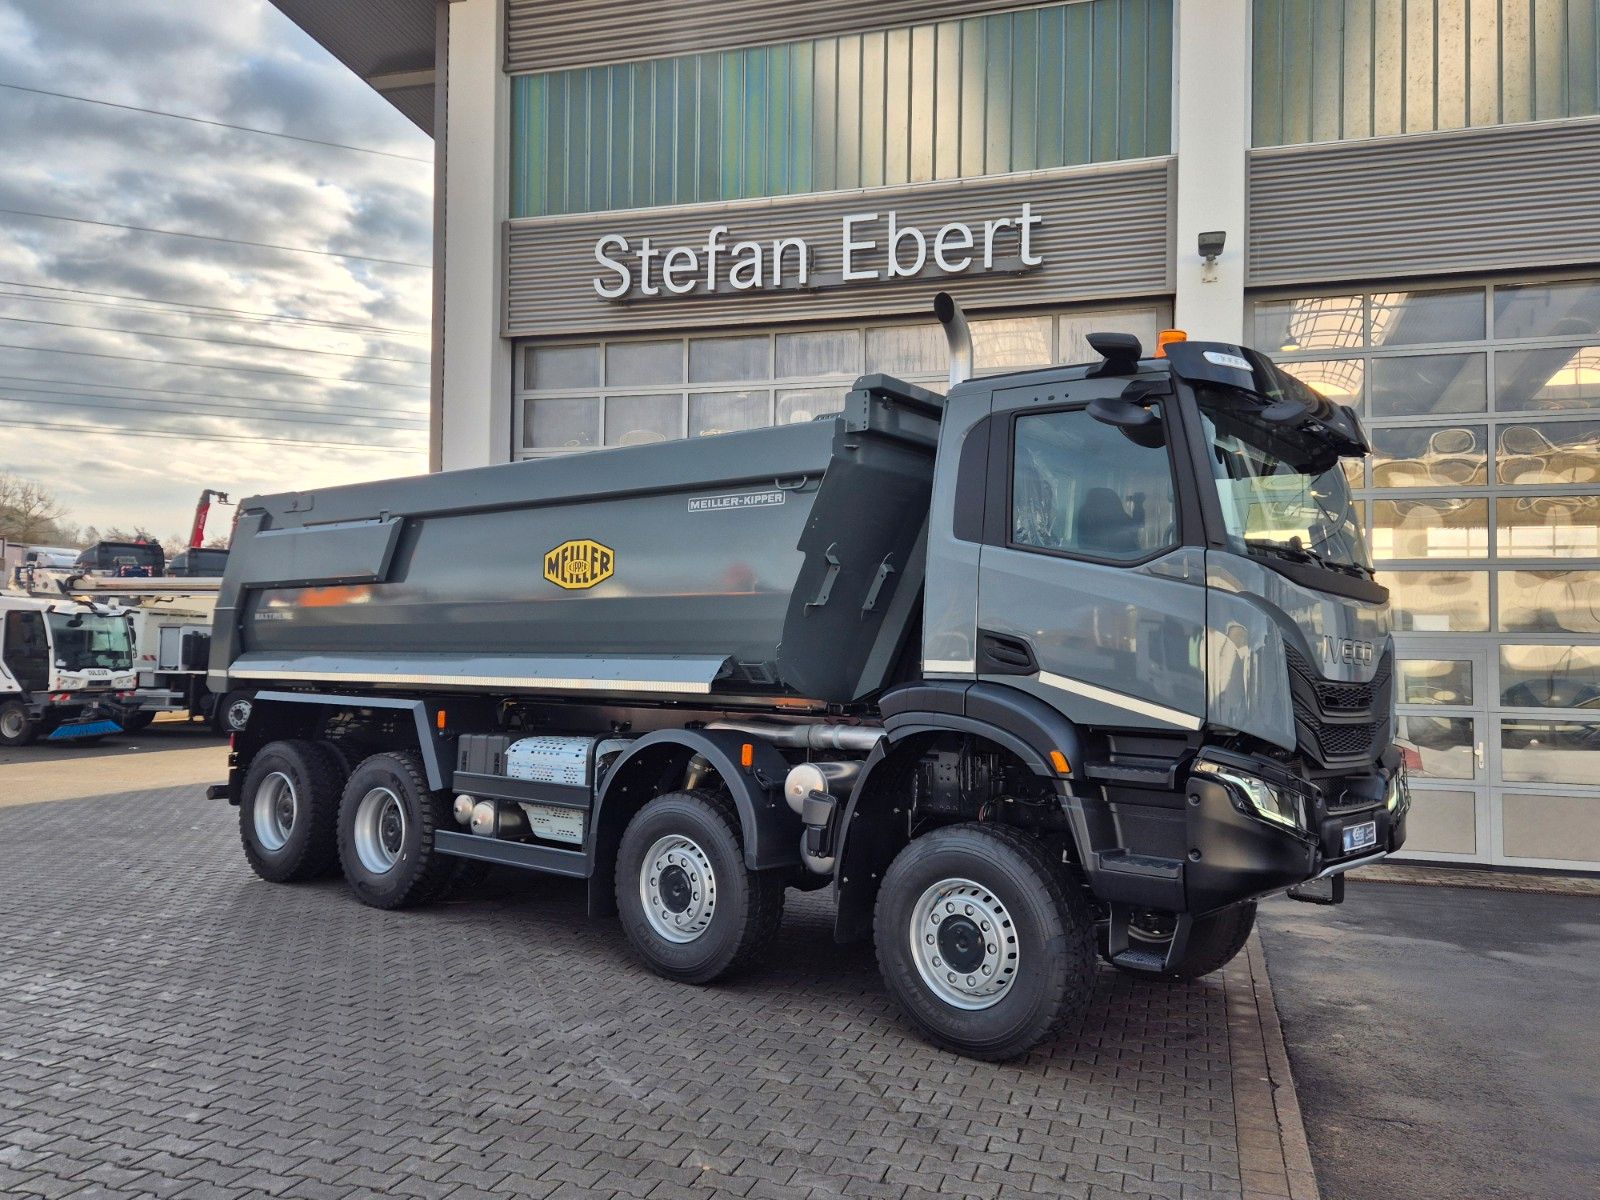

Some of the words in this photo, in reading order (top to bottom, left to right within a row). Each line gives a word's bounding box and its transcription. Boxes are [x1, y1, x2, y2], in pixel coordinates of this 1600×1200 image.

[592, 226, 808, 299] Stefan
[842, 202, 1043, 281] Ebert
[690, 492, 783, 510] MEILLER-KIPPER
[547, 545, 611, 583] MEILLER
[568, 561, 589, 573] KIPPER
[1323, 635, 1374, 666] IVECO
